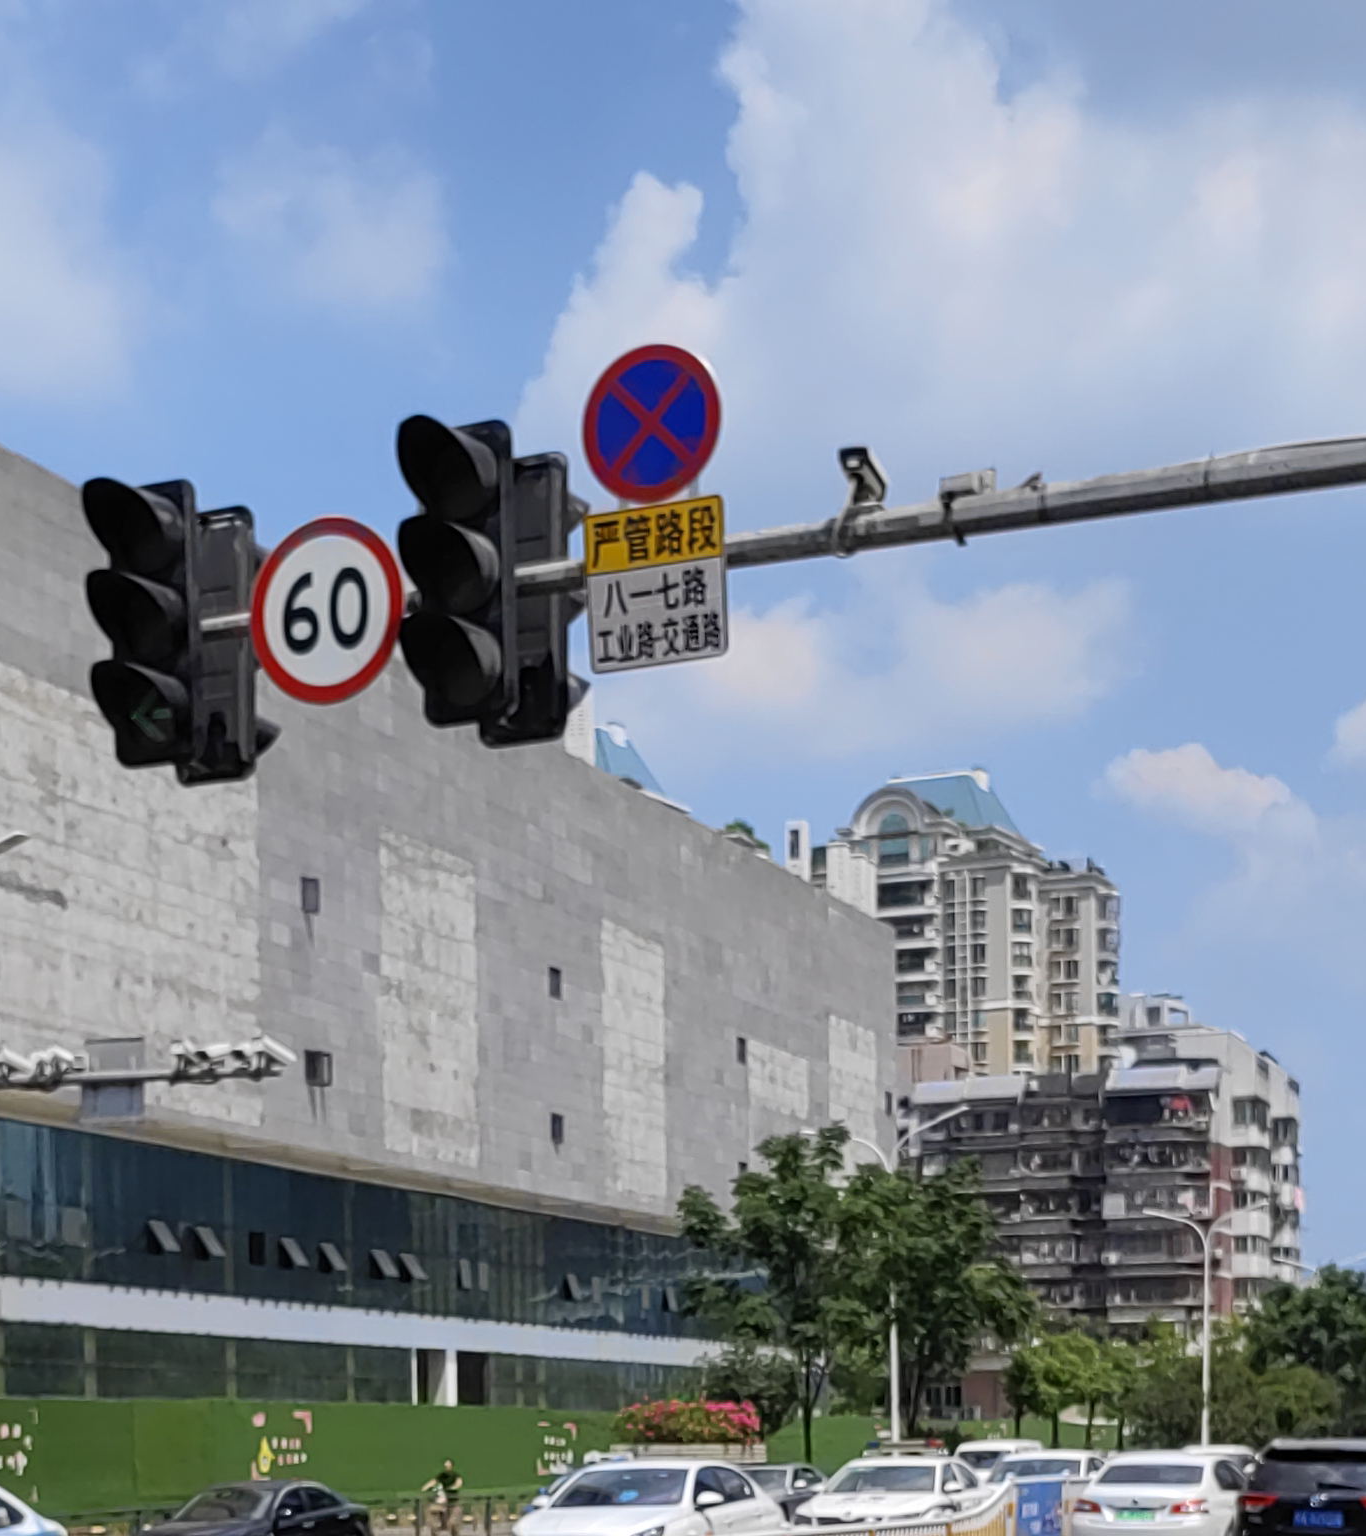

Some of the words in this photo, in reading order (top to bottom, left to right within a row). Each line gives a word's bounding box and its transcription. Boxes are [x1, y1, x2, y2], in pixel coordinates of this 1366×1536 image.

[592, 505, 716, 568] 严管路段
[283, 567, 368, 655] 60
[604, 566, 707, 618] 八一七路
